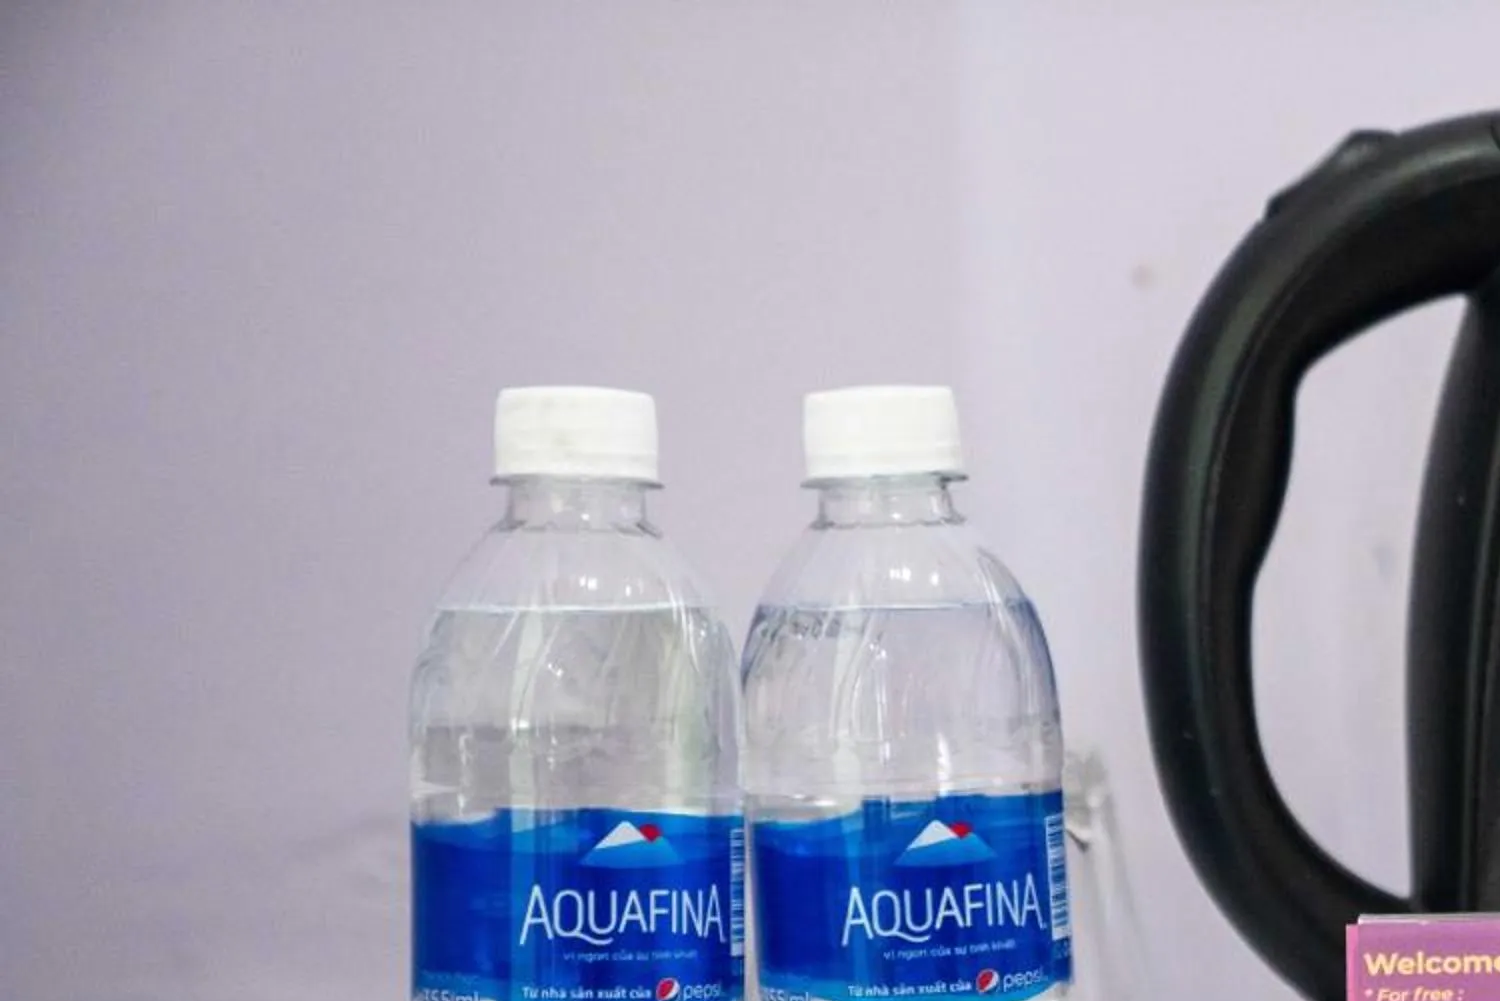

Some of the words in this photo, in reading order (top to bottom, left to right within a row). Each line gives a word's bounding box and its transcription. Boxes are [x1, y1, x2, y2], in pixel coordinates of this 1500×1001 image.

[519, 884, 726, 946] AQUAFINA
[842, 872, 1046, 947] AQUAFINA
[683, 983, 721, 1001] pepsi
[1003, 967, 1045, 993] pepsi
[1413, 986, 1453, 1001] free
